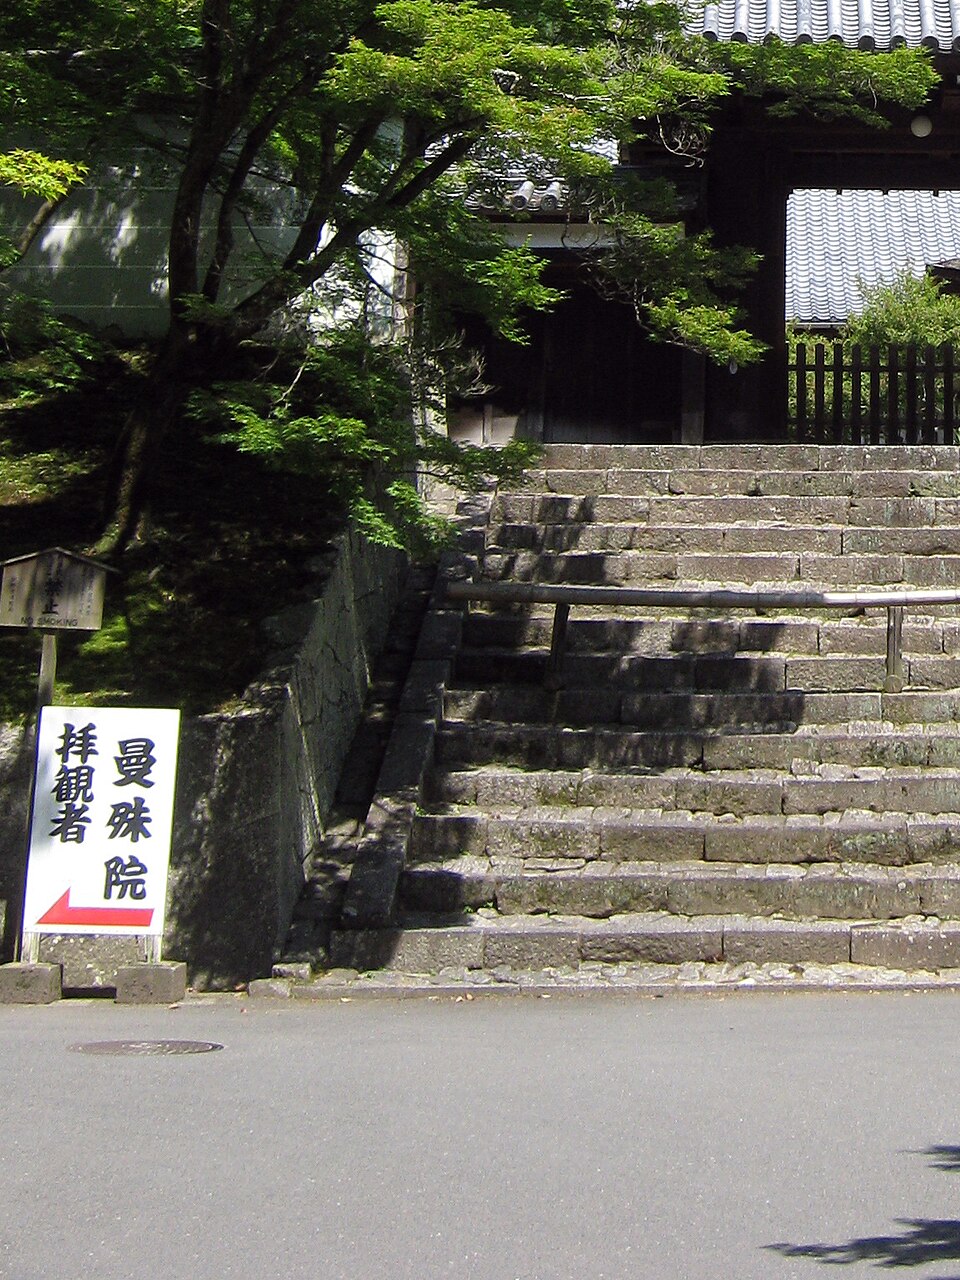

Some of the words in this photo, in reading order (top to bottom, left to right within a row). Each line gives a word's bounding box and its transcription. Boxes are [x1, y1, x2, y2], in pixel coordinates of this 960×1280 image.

[20, 616, 34, 626] NO
[37, 617, 78, 627] SMOKING
[48, 722, 99, 844] 拝観者
[103, 737, 157, 900] 曼殊院
